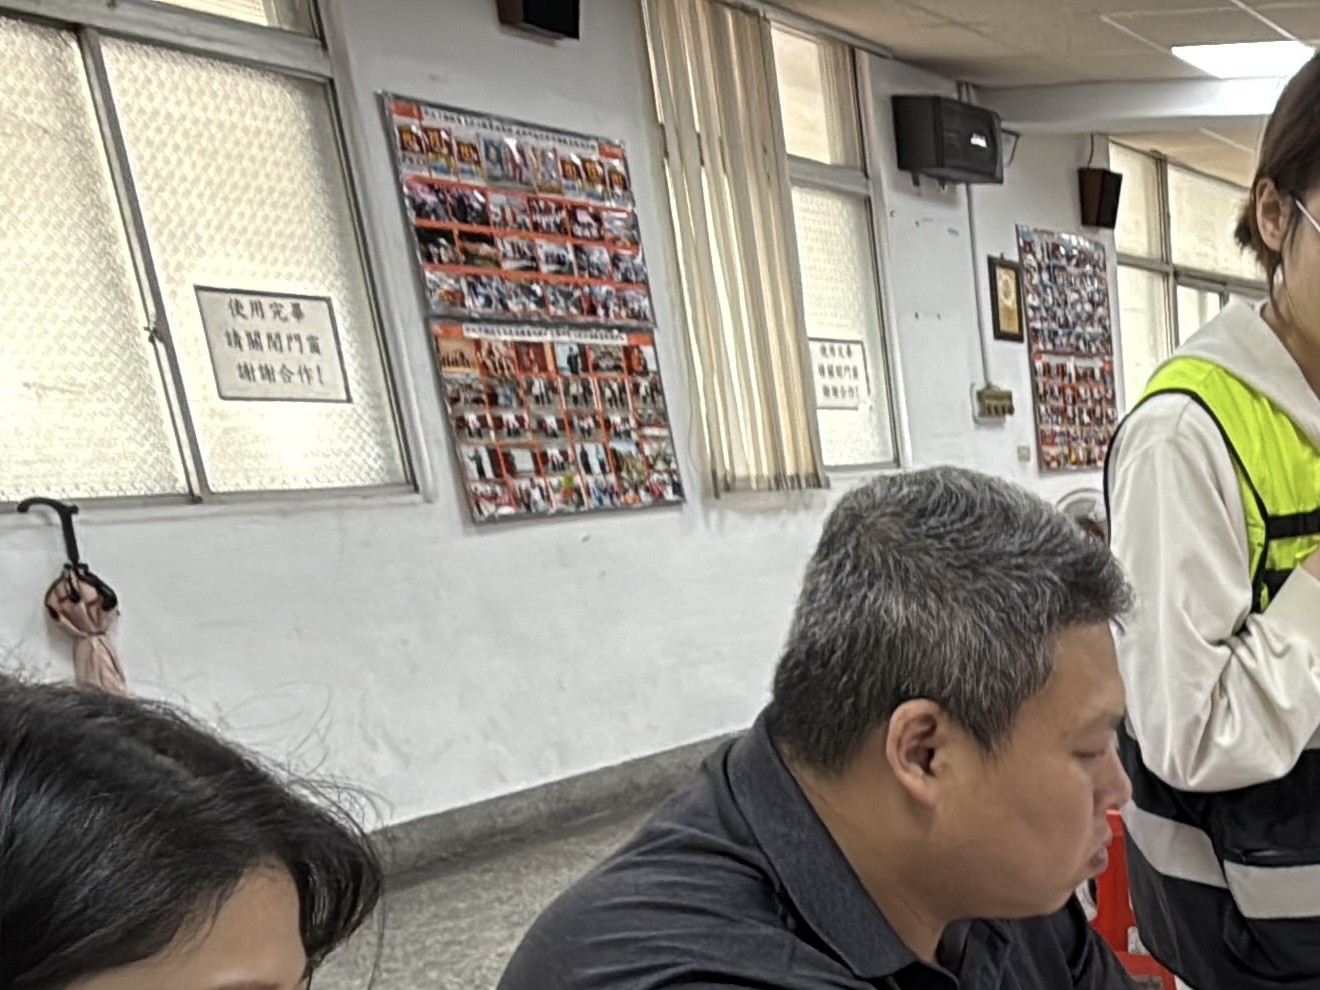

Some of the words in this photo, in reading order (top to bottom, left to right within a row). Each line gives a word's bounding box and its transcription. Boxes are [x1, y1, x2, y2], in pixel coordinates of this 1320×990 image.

[228, 298, 305, 323] 使用完畢
[225, 329, 321, 355] 請關閉門窗
